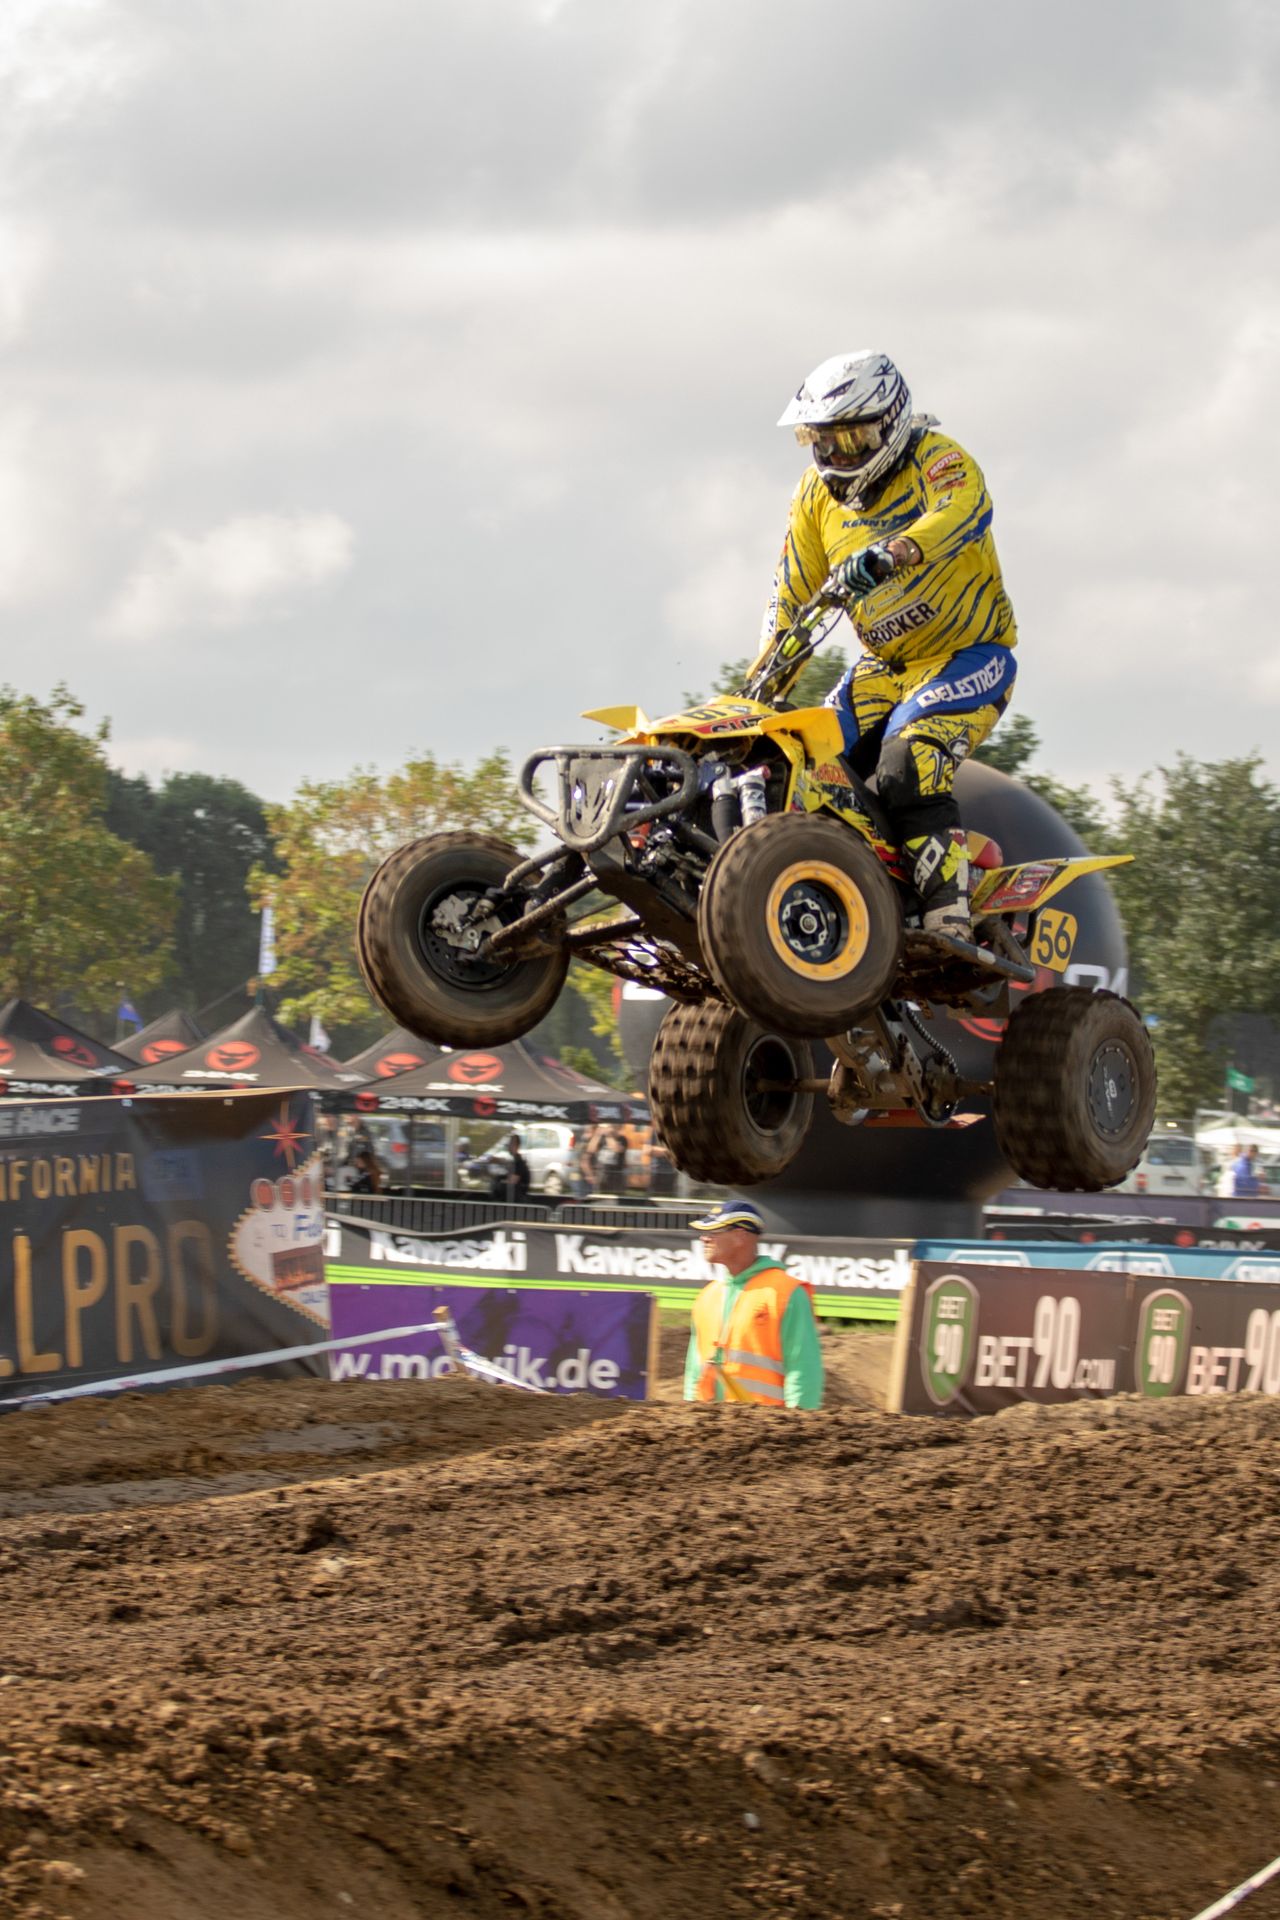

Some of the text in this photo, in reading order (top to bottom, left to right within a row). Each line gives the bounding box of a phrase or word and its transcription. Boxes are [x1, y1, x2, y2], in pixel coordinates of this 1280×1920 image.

[929, 452, 962, 477] MOTUL
[916, 656, 1004, 708] DELESTREZ
[1036, 915, 1071, 965] 56
[368, 1228, 528, 1271] Kawasaki
[0, 1219, 220, 1378] LPRO
[936, 1295, 968, 1319] BET
[1151, 1308, 1181, 1331] BET
[933, 1323, 965, 1375] 90
[1147, 1334, 1178, 1383] 90
